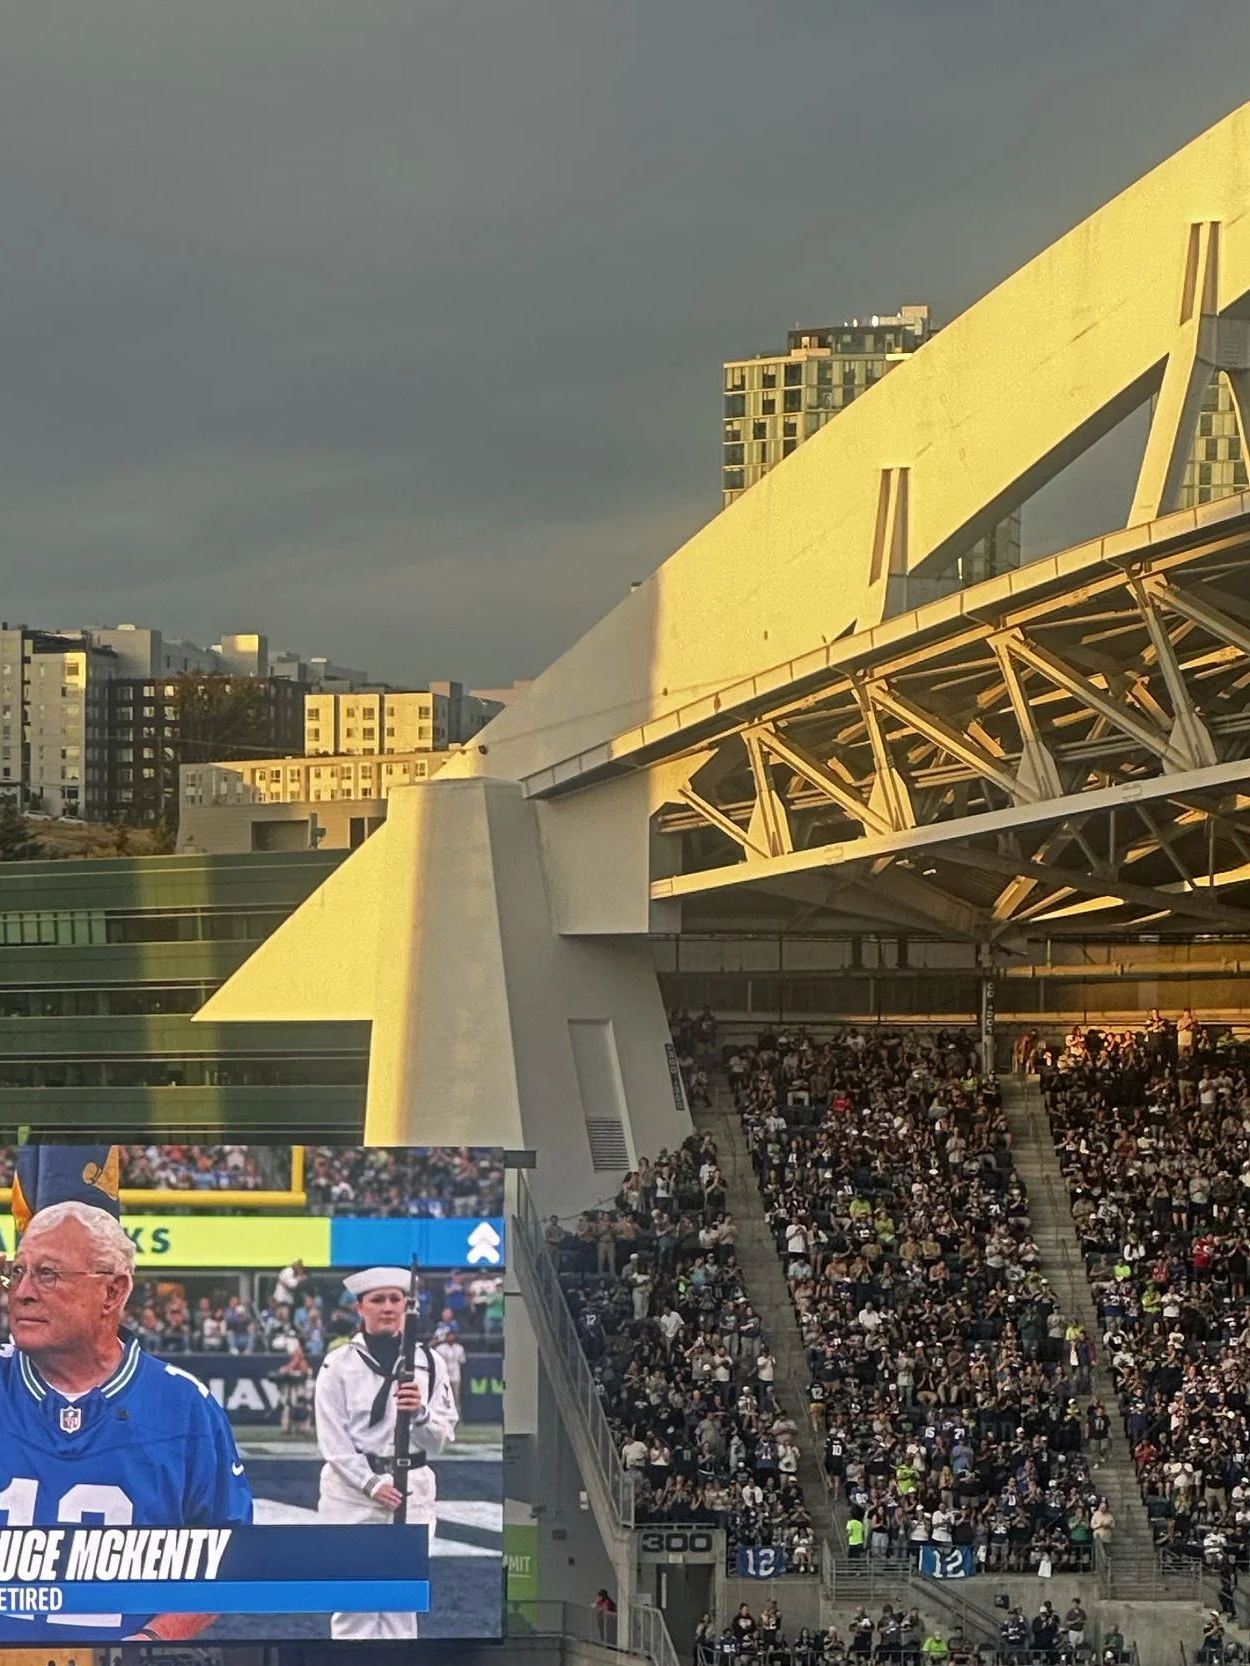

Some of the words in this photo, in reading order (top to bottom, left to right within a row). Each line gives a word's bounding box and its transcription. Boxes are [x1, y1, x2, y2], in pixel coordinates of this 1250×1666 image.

[66, 1529, 232, 1581] MCKENTY
[642, 1533, 712, 1553] 300
[747, 1549, 776, 1577] 12
[931, 1549, 966, 1578] 12
